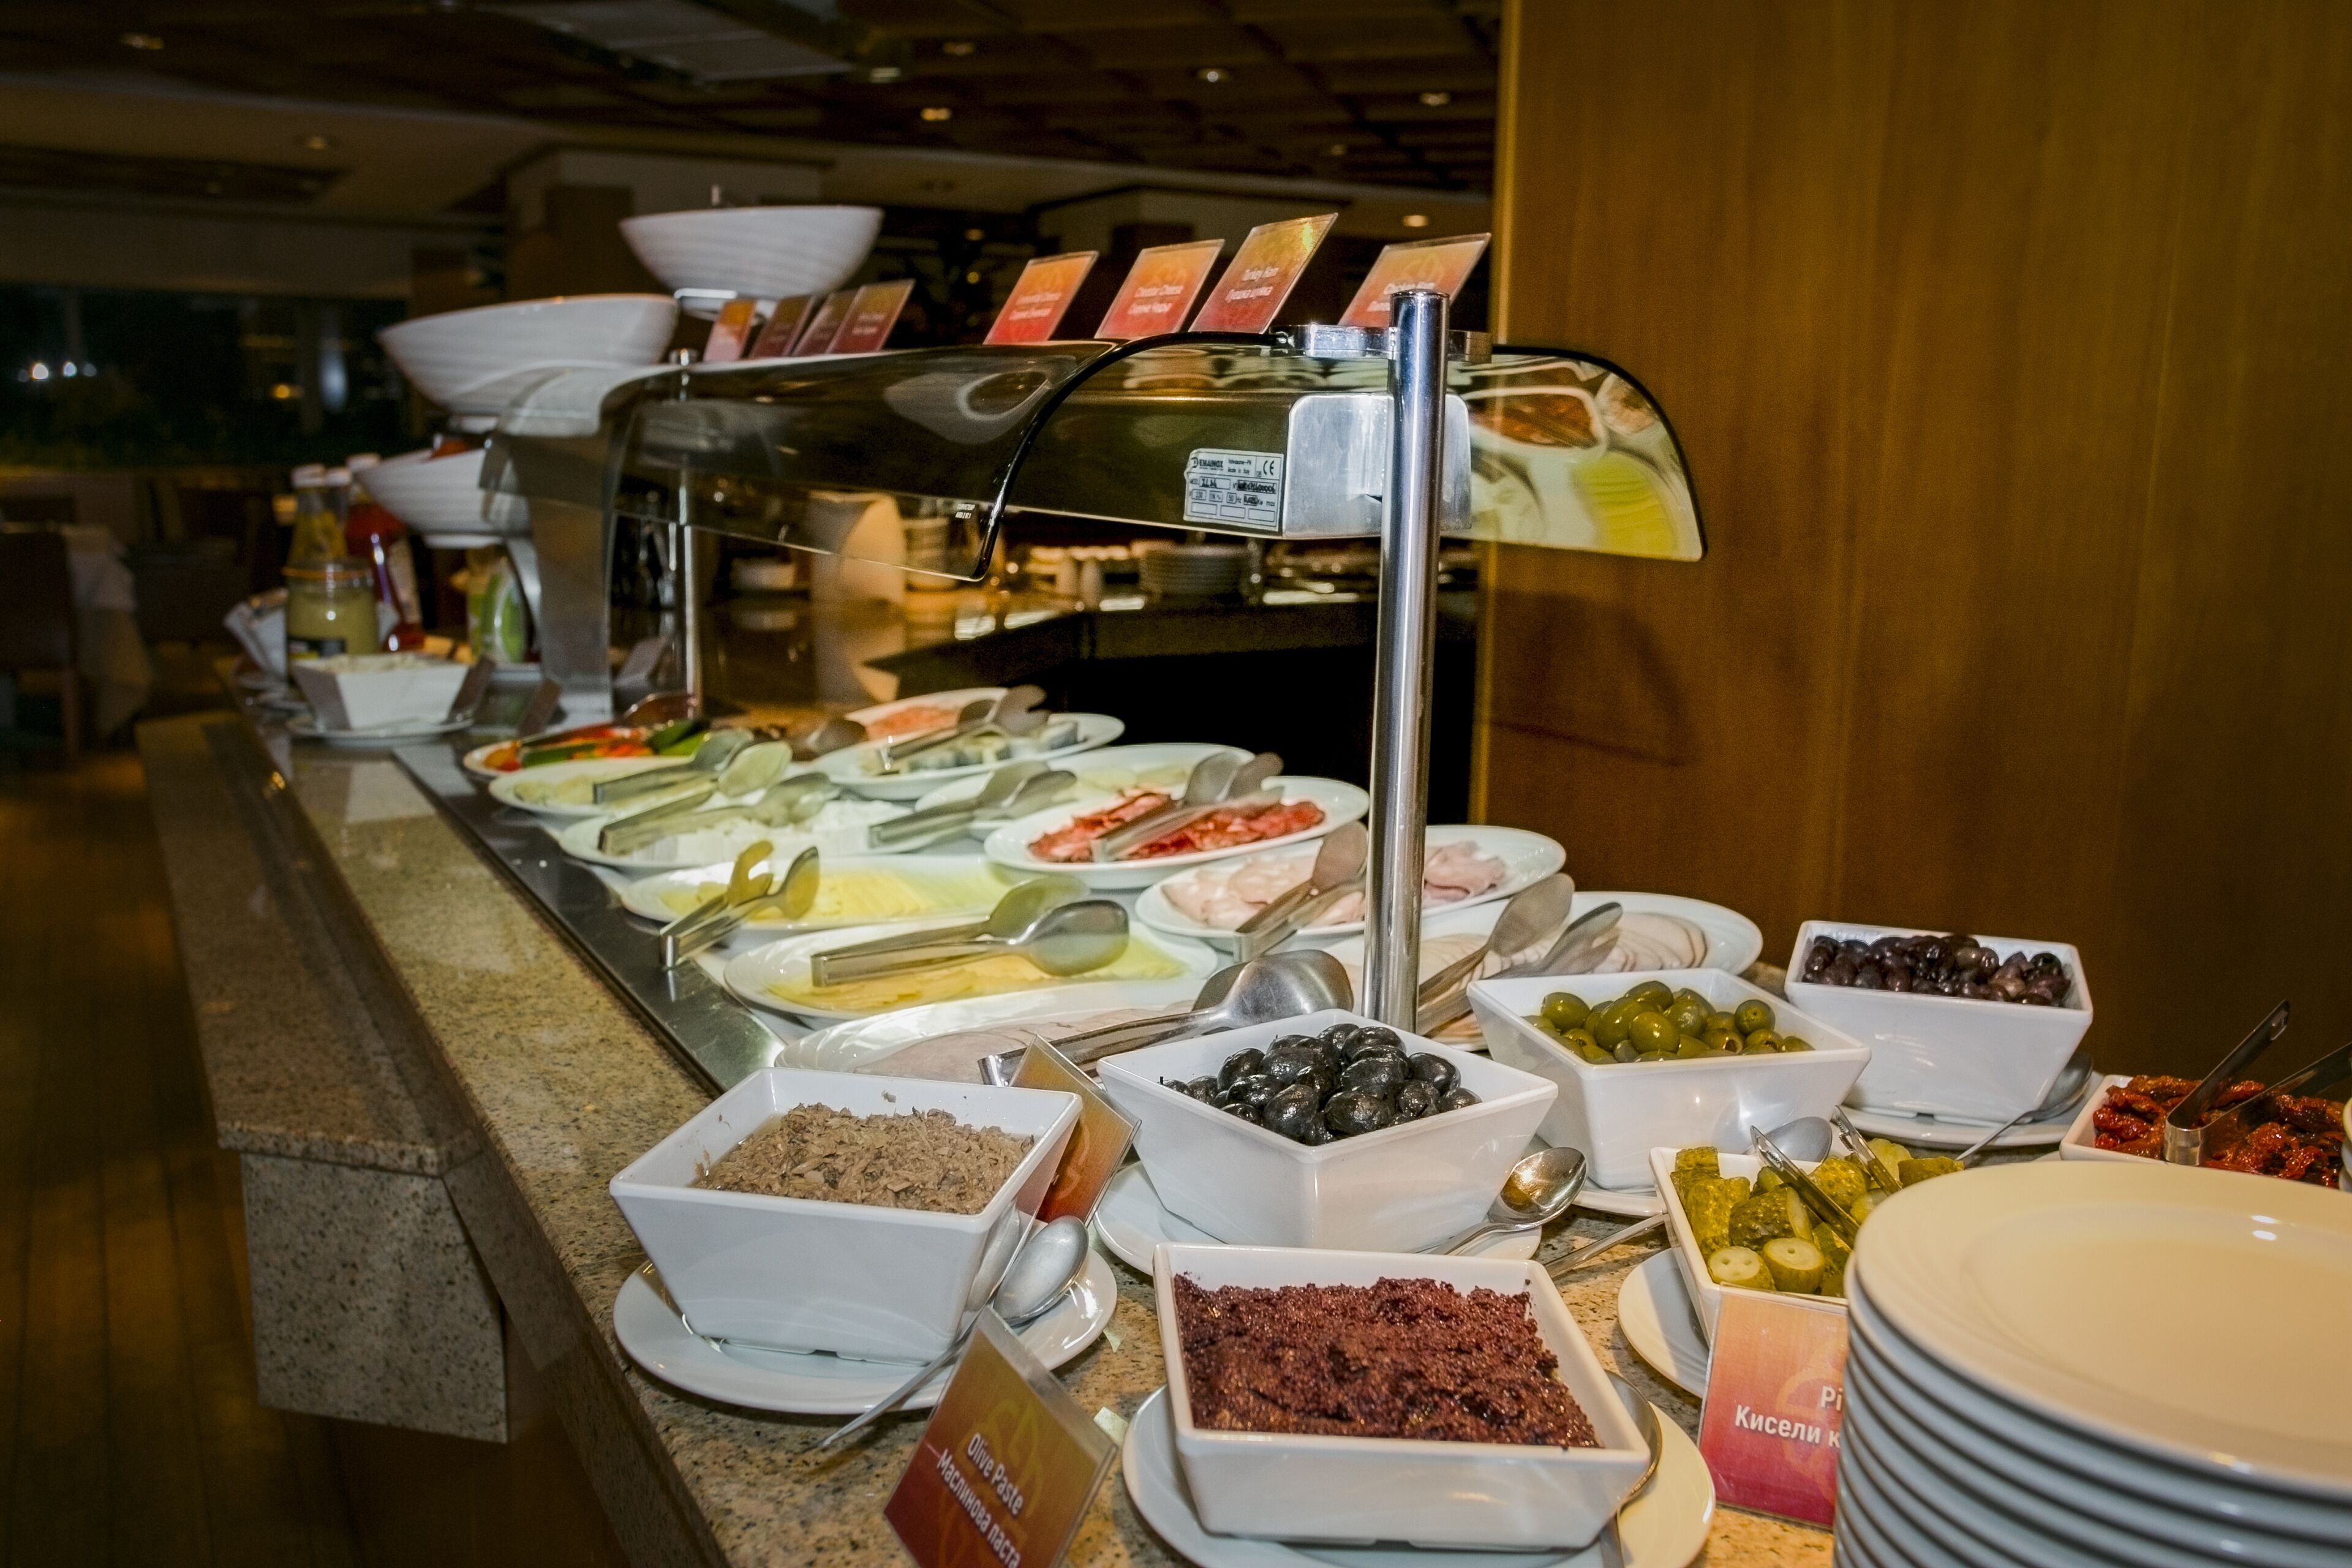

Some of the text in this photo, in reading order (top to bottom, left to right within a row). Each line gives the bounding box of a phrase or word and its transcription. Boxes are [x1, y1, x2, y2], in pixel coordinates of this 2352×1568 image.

[1735, 1403, 1821, 1445] Кисели
[935, 1447, 1021, 1568] Маслинова паста
[967, 1431, 1024, 1516] Olive Paste
